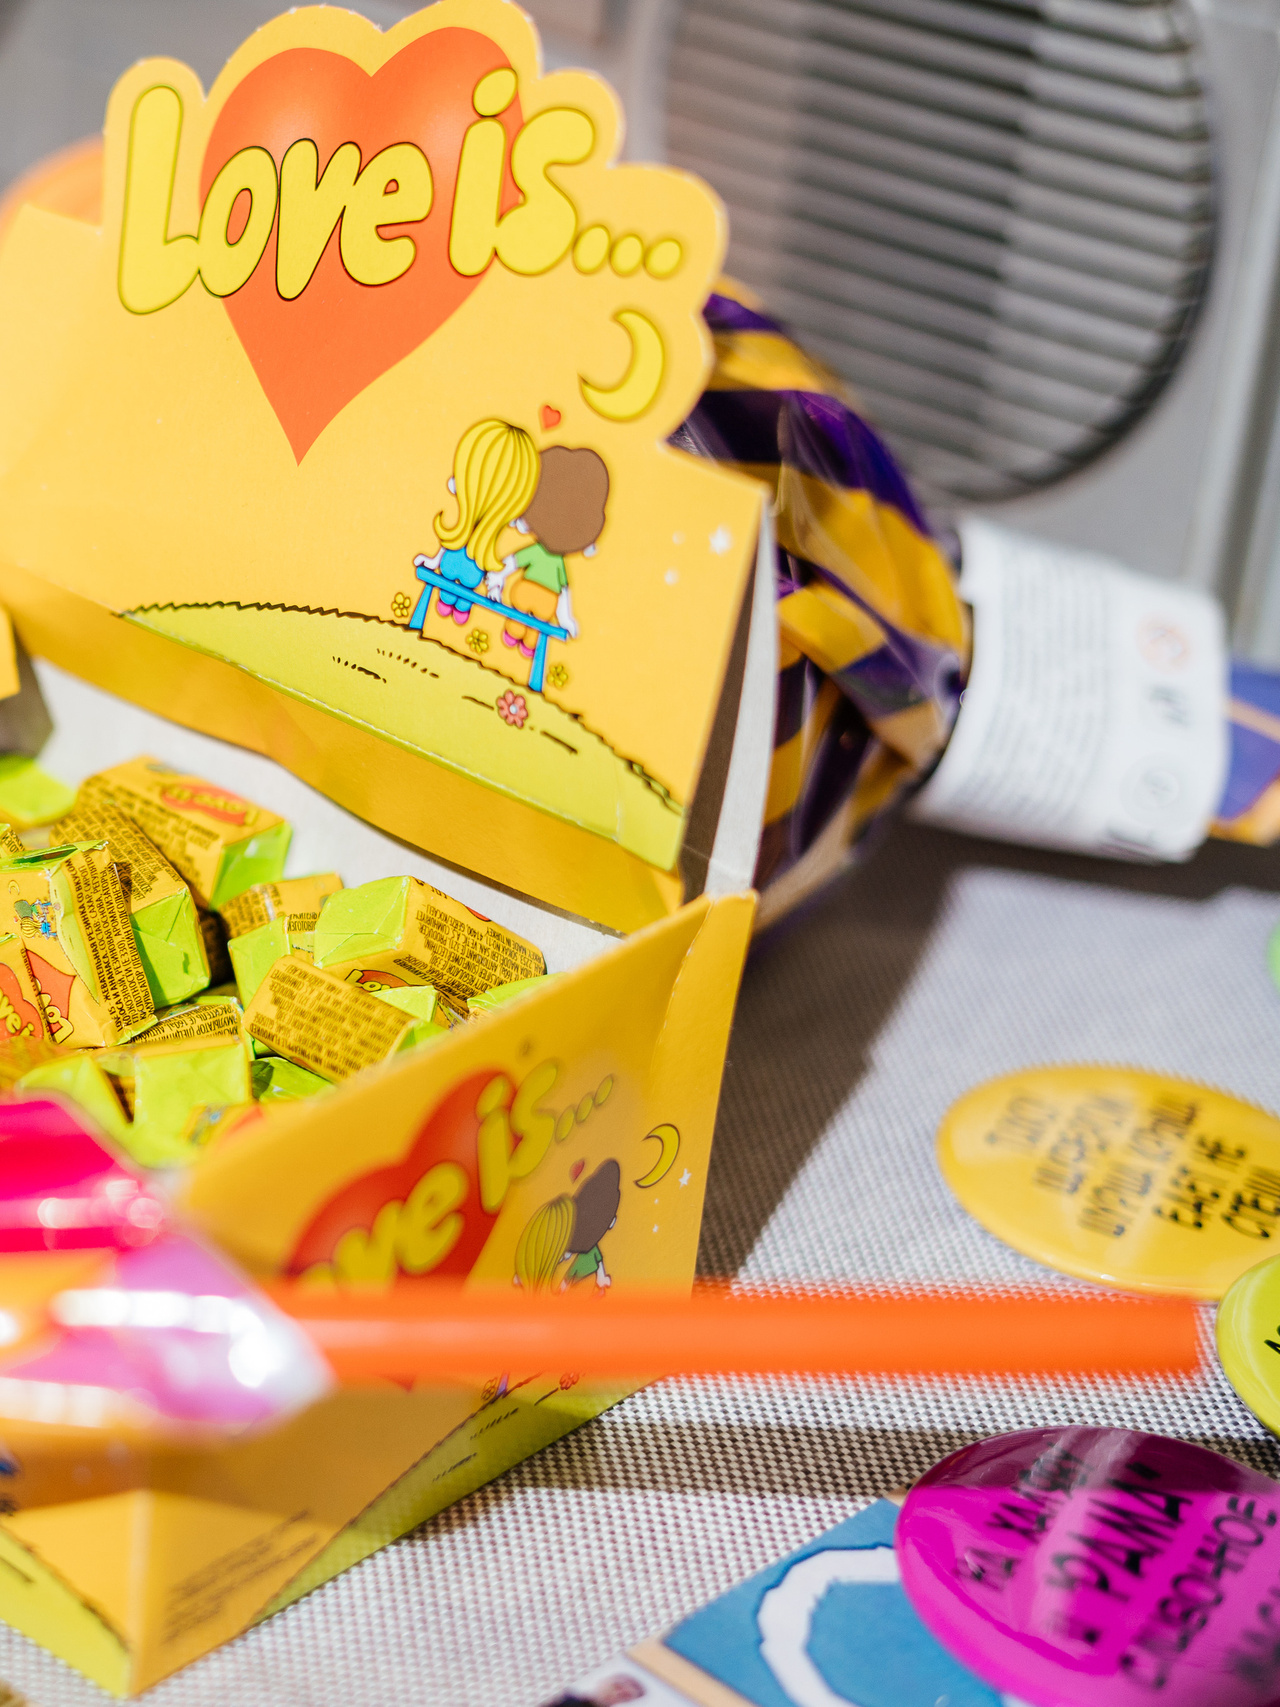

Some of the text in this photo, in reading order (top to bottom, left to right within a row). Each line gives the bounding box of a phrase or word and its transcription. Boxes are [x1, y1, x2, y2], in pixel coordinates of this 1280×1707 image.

[118, 67, 682, 316] Love is...
[74, 892, 85, 902] СО
[77, 864, 92, 890] СИРОП
[77, 903, 96, 941] РЕЗИНКА
[89, 941, 112, 1001] ЖЕВАТЕЛЬНАЯ
[102, 928, 123, 974] РЕЗИНОВАЯ
[123, 966, 147, 1020] КИСЛОТНОСТИ
